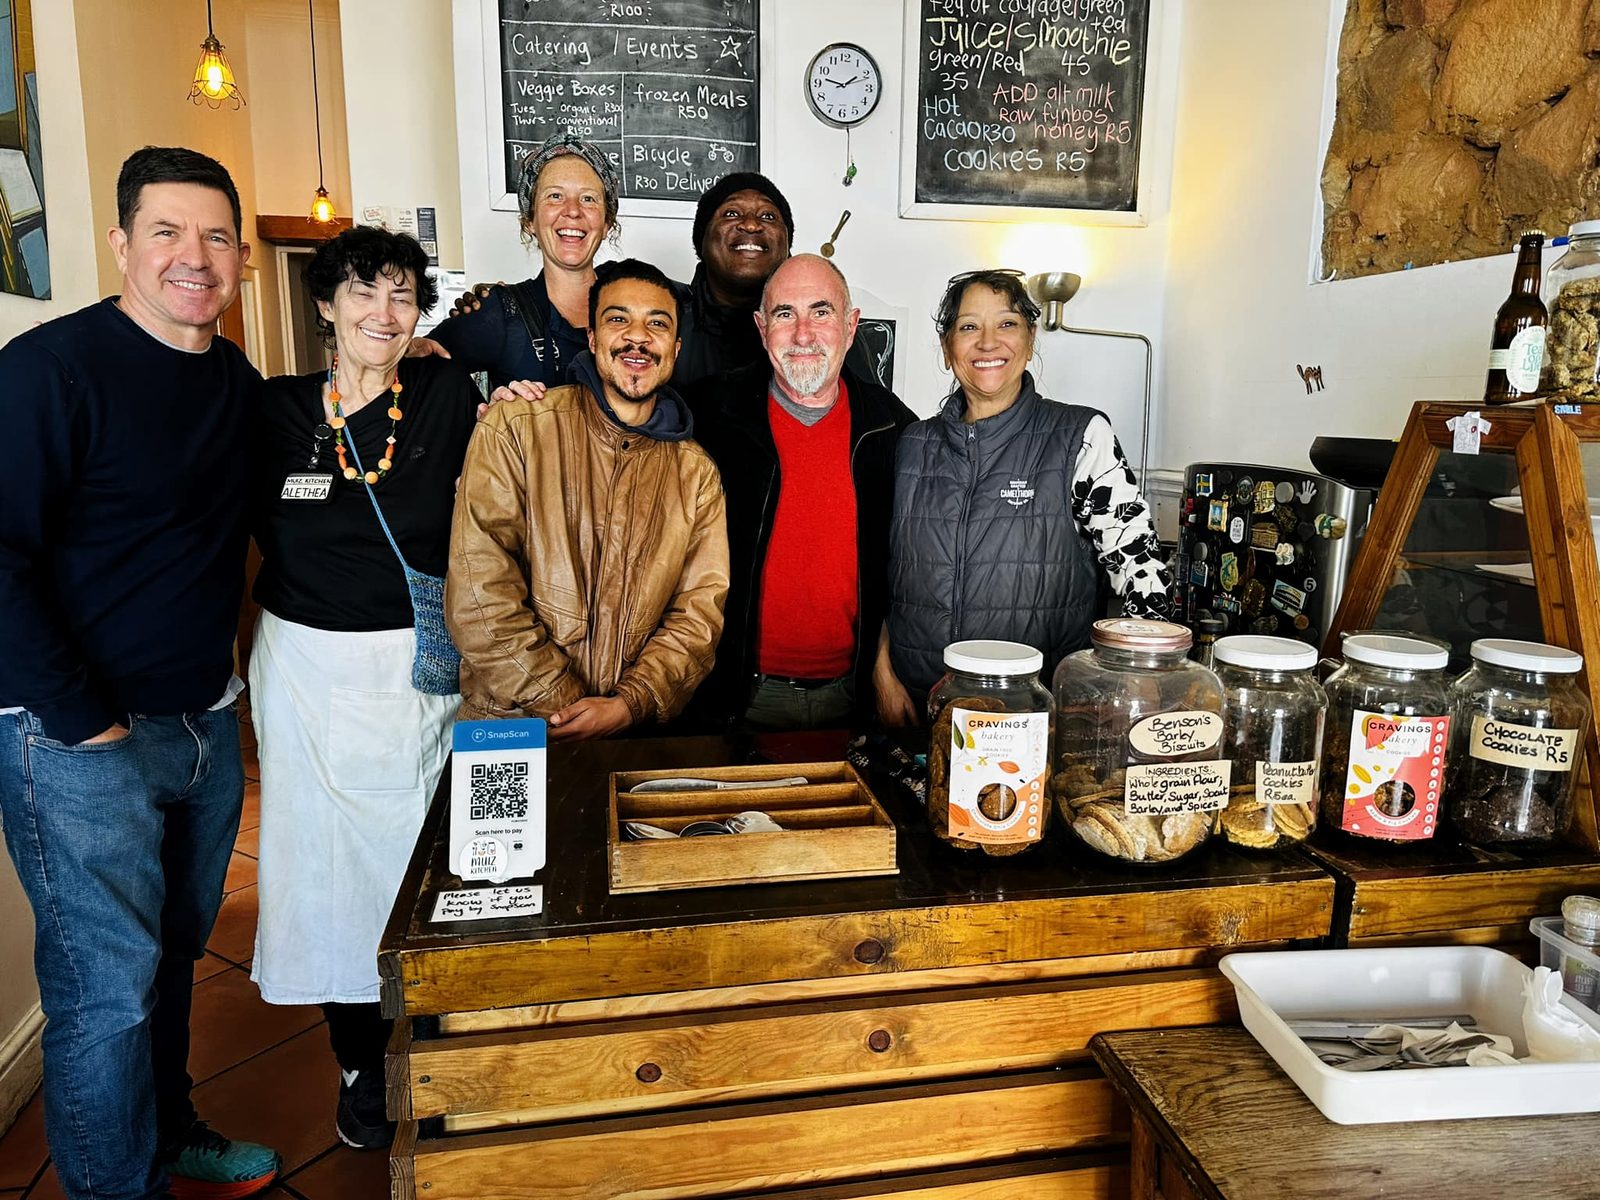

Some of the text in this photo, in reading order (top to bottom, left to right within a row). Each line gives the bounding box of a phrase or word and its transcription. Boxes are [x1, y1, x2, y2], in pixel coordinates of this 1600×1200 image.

[609, 3, 642, 17] R100
[512, 33, 591, 65] Catering
[627, 36, 698, 59] Events
[829, 56, 838, 65] 11
[840, 53, 851, 63] 12
[856, 59, 859, 67] 1
[820, 66, 830, 75] 10
[863, 70, 870, 79] 2
[814, 79, 822, 88] 9
[865, 84, 873, 93] 3
[517, 80, 615, 102] Veggie Boxes
[817, 92, 826, 101] 8
[993, 80, 1116, 112] ADD alt milk
[697, 85, 748, 109] Meals
[861, 97, 867, 105] 4
[510, 102, 536, 114] Tues
[827, 104, 834, 113] 7
[851, 106, 859, 115] 5
[923, 94, 961, 117] Hot
[678, 105, 708, 119] R50
[838, 109, 846, 118] 6
[1042, 102, 1108, 128] fynbos
[512, 115, 546, 126] Thurs
[567, 126, 592, 136] R150
[1034, 121, 1132, 153] honey R5
[633, 144, 693, 169] Bicycle
[1056, 151, 1086, 171] R5
[635, 175, 658, 190] R30
[282, 487, 327, 498] ALETHEA
[1306, 580, 1314, 591] 5
[968, 720, 1028, 729] CRAVINGS
[1147, 715, 1211, 731] Benson's
[1369, 722, 1431, 733] CRAVINGS
[487, 730, 529, 740] SnapScan
[981, 731, 1014, 741] bakery
[1382, 733, 1417, 744] bakery
[1484, 722, 1563, 747] CHOCOLATE
[1158, 740, 1206, 754] Biscuits
[1546, 747, 1568, 763] R5
[1168, 791, 1201, 805] Sugar,
[1187, 800, 1219, 813] Spices
[509, 895, 532, 904] you
[469, 906, 482, 915] by
